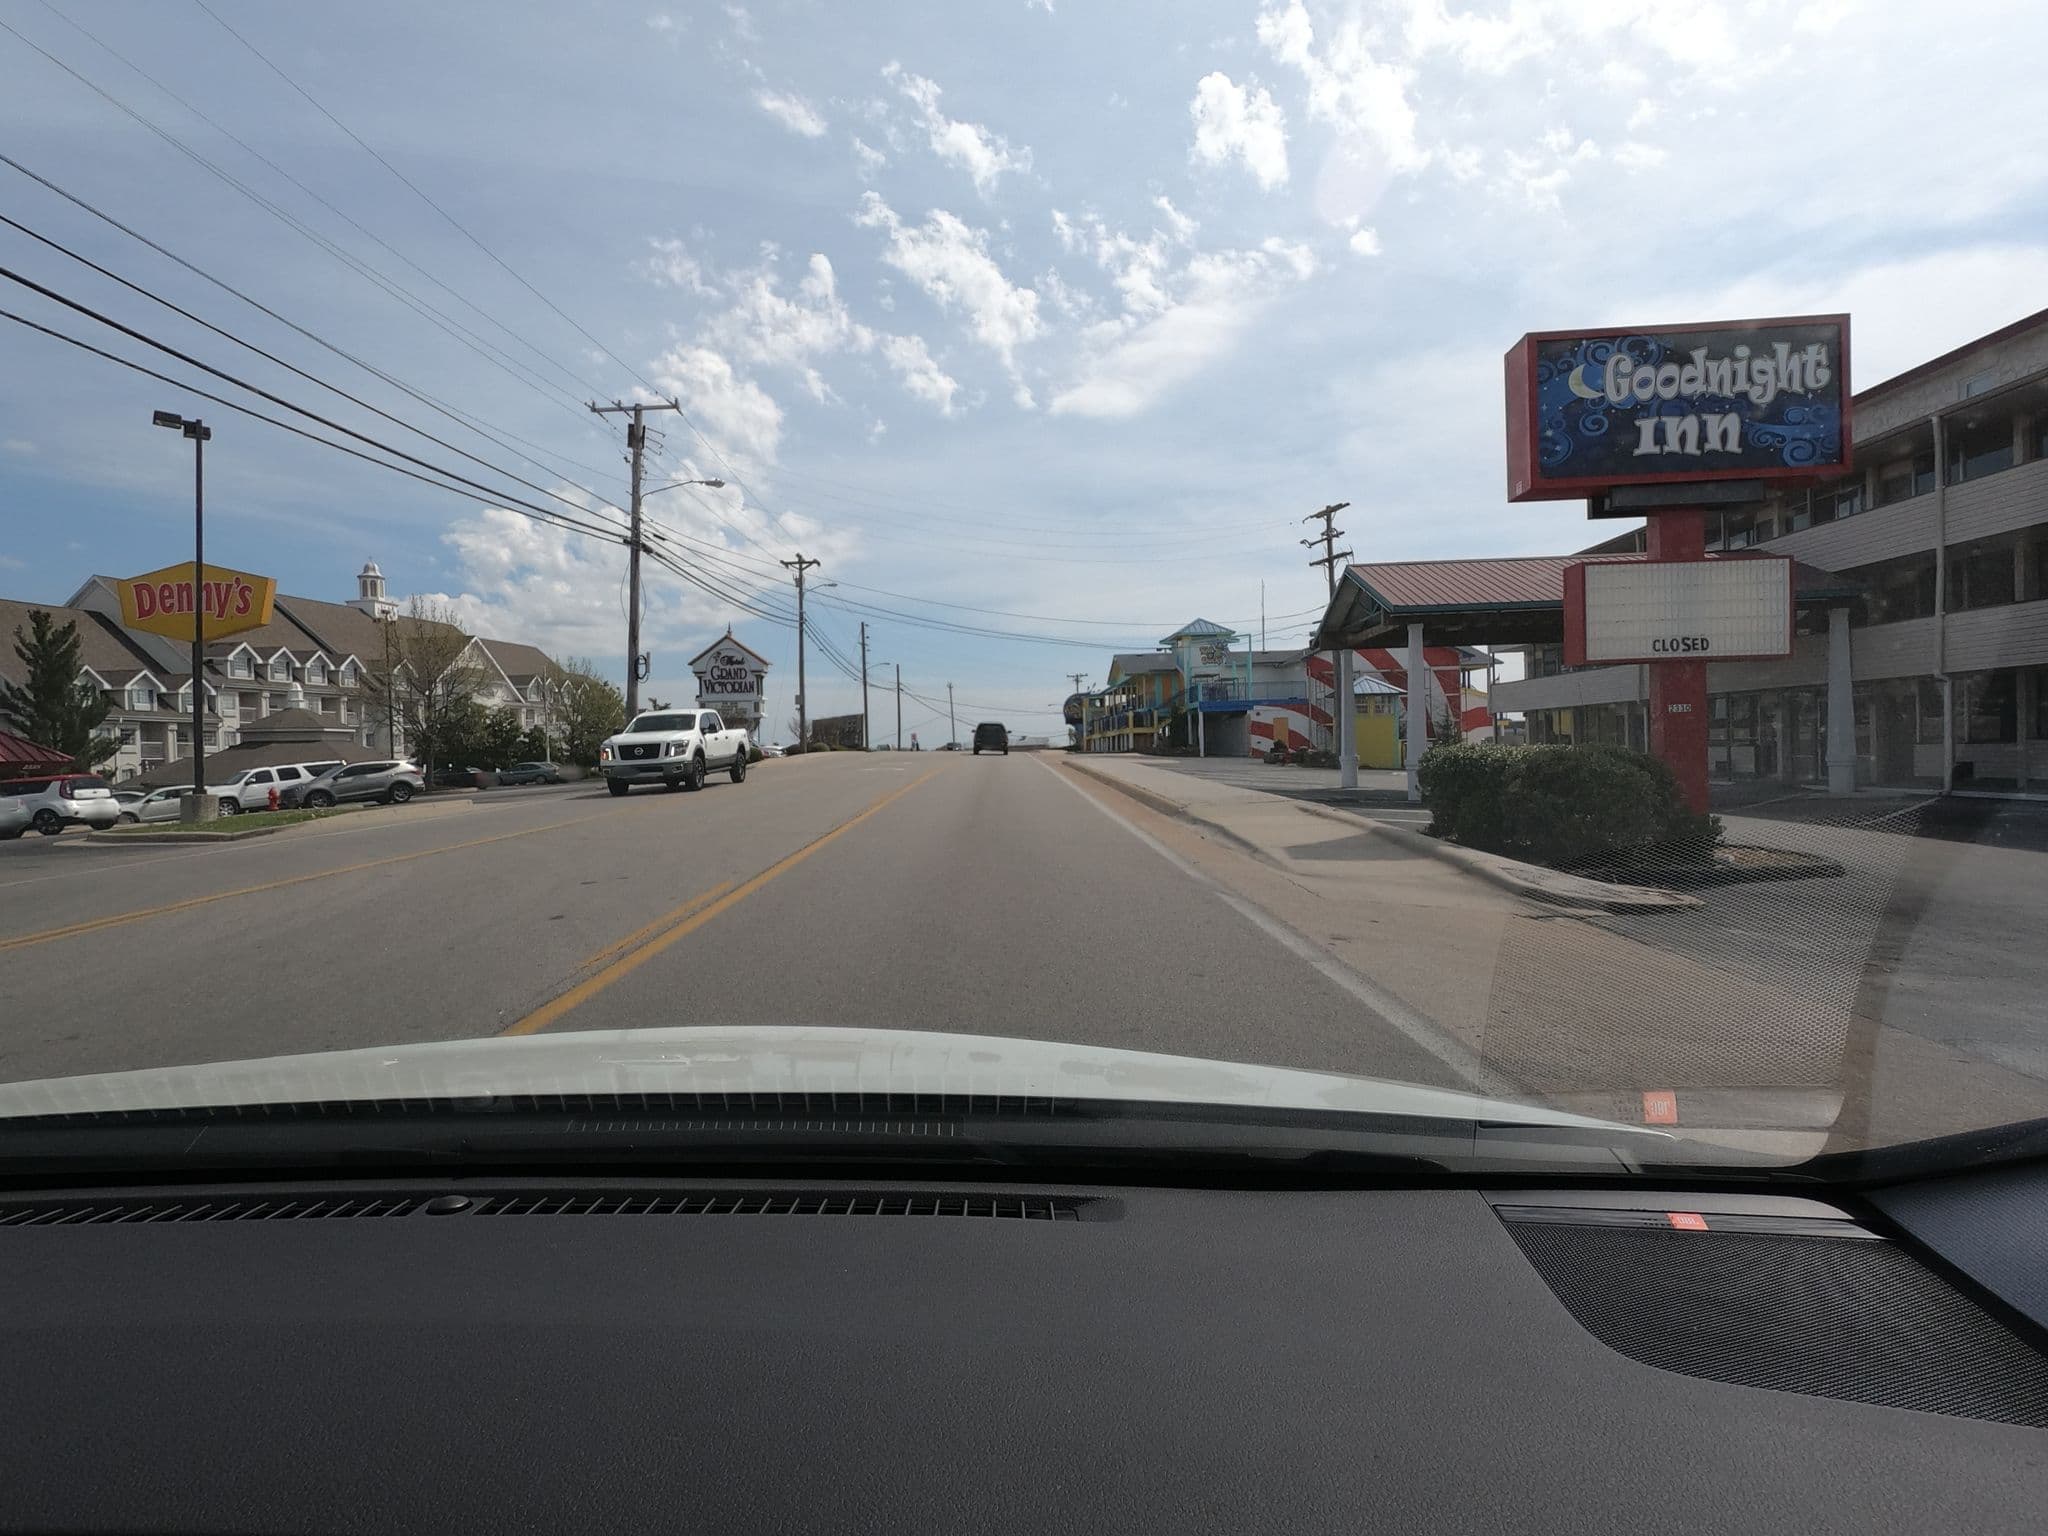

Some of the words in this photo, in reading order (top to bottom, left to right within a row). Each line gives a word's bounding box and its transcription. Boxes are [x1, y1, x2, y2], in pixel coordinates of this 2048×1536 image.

[1603, 342, 1831, 406] Goodnight
[132, 576, 253, 620] Denny's
[1652, 637, 1710, 652] CLOSED
[711, 666, 748, 680] GRAND
[703, 680, 755, 694] VICTORIAN
